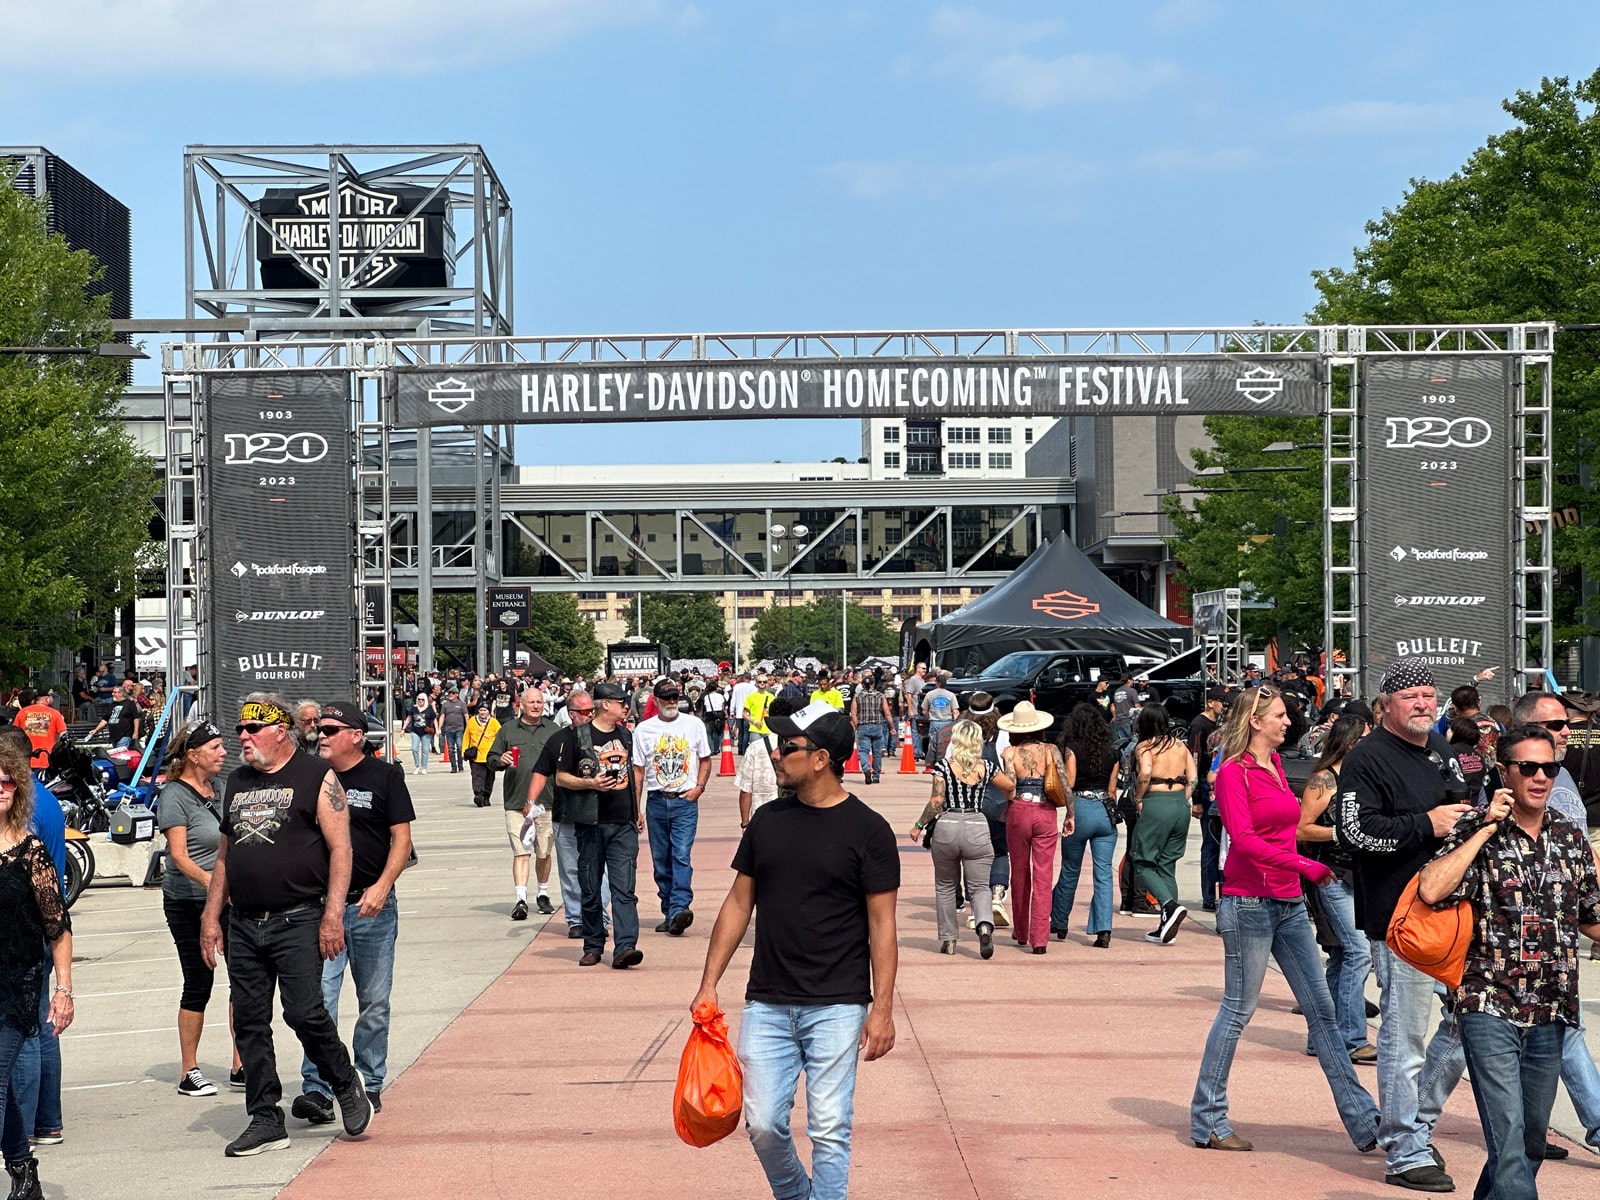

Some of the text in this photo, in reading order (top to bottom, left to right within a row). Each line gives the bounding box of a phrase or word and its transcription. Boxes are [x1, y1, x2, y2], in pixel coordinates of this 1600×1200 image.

[1058, 366, 1189, 405] FESTIVAL
[1422, 395, 1456, 404] 1903
[259, 410, 293, 420] 1903
[1386, 416, 1492, 448] 120
[224, 432, 329, 465] 120
[1420, 461, 1458, 470] 2023
[259, 476, 296, 486] 2023
[1411, 547, 1489, 562] Rockford Fosgate
[251, 562, 327, 577] Rockford Fosgate
[1408, 596, 1486, 605] DUNLOP
[249, 610, 325, 621] DUNLOP
[1396, 637, 1483, 657] BULLEIT
[238, 652, 323, 673] BULLEIT
[612, 657, 658, 669] V-TWIN
[1420, 656, 1465, 665] OURBON
[255, 671, 305, 680] BOURBON
